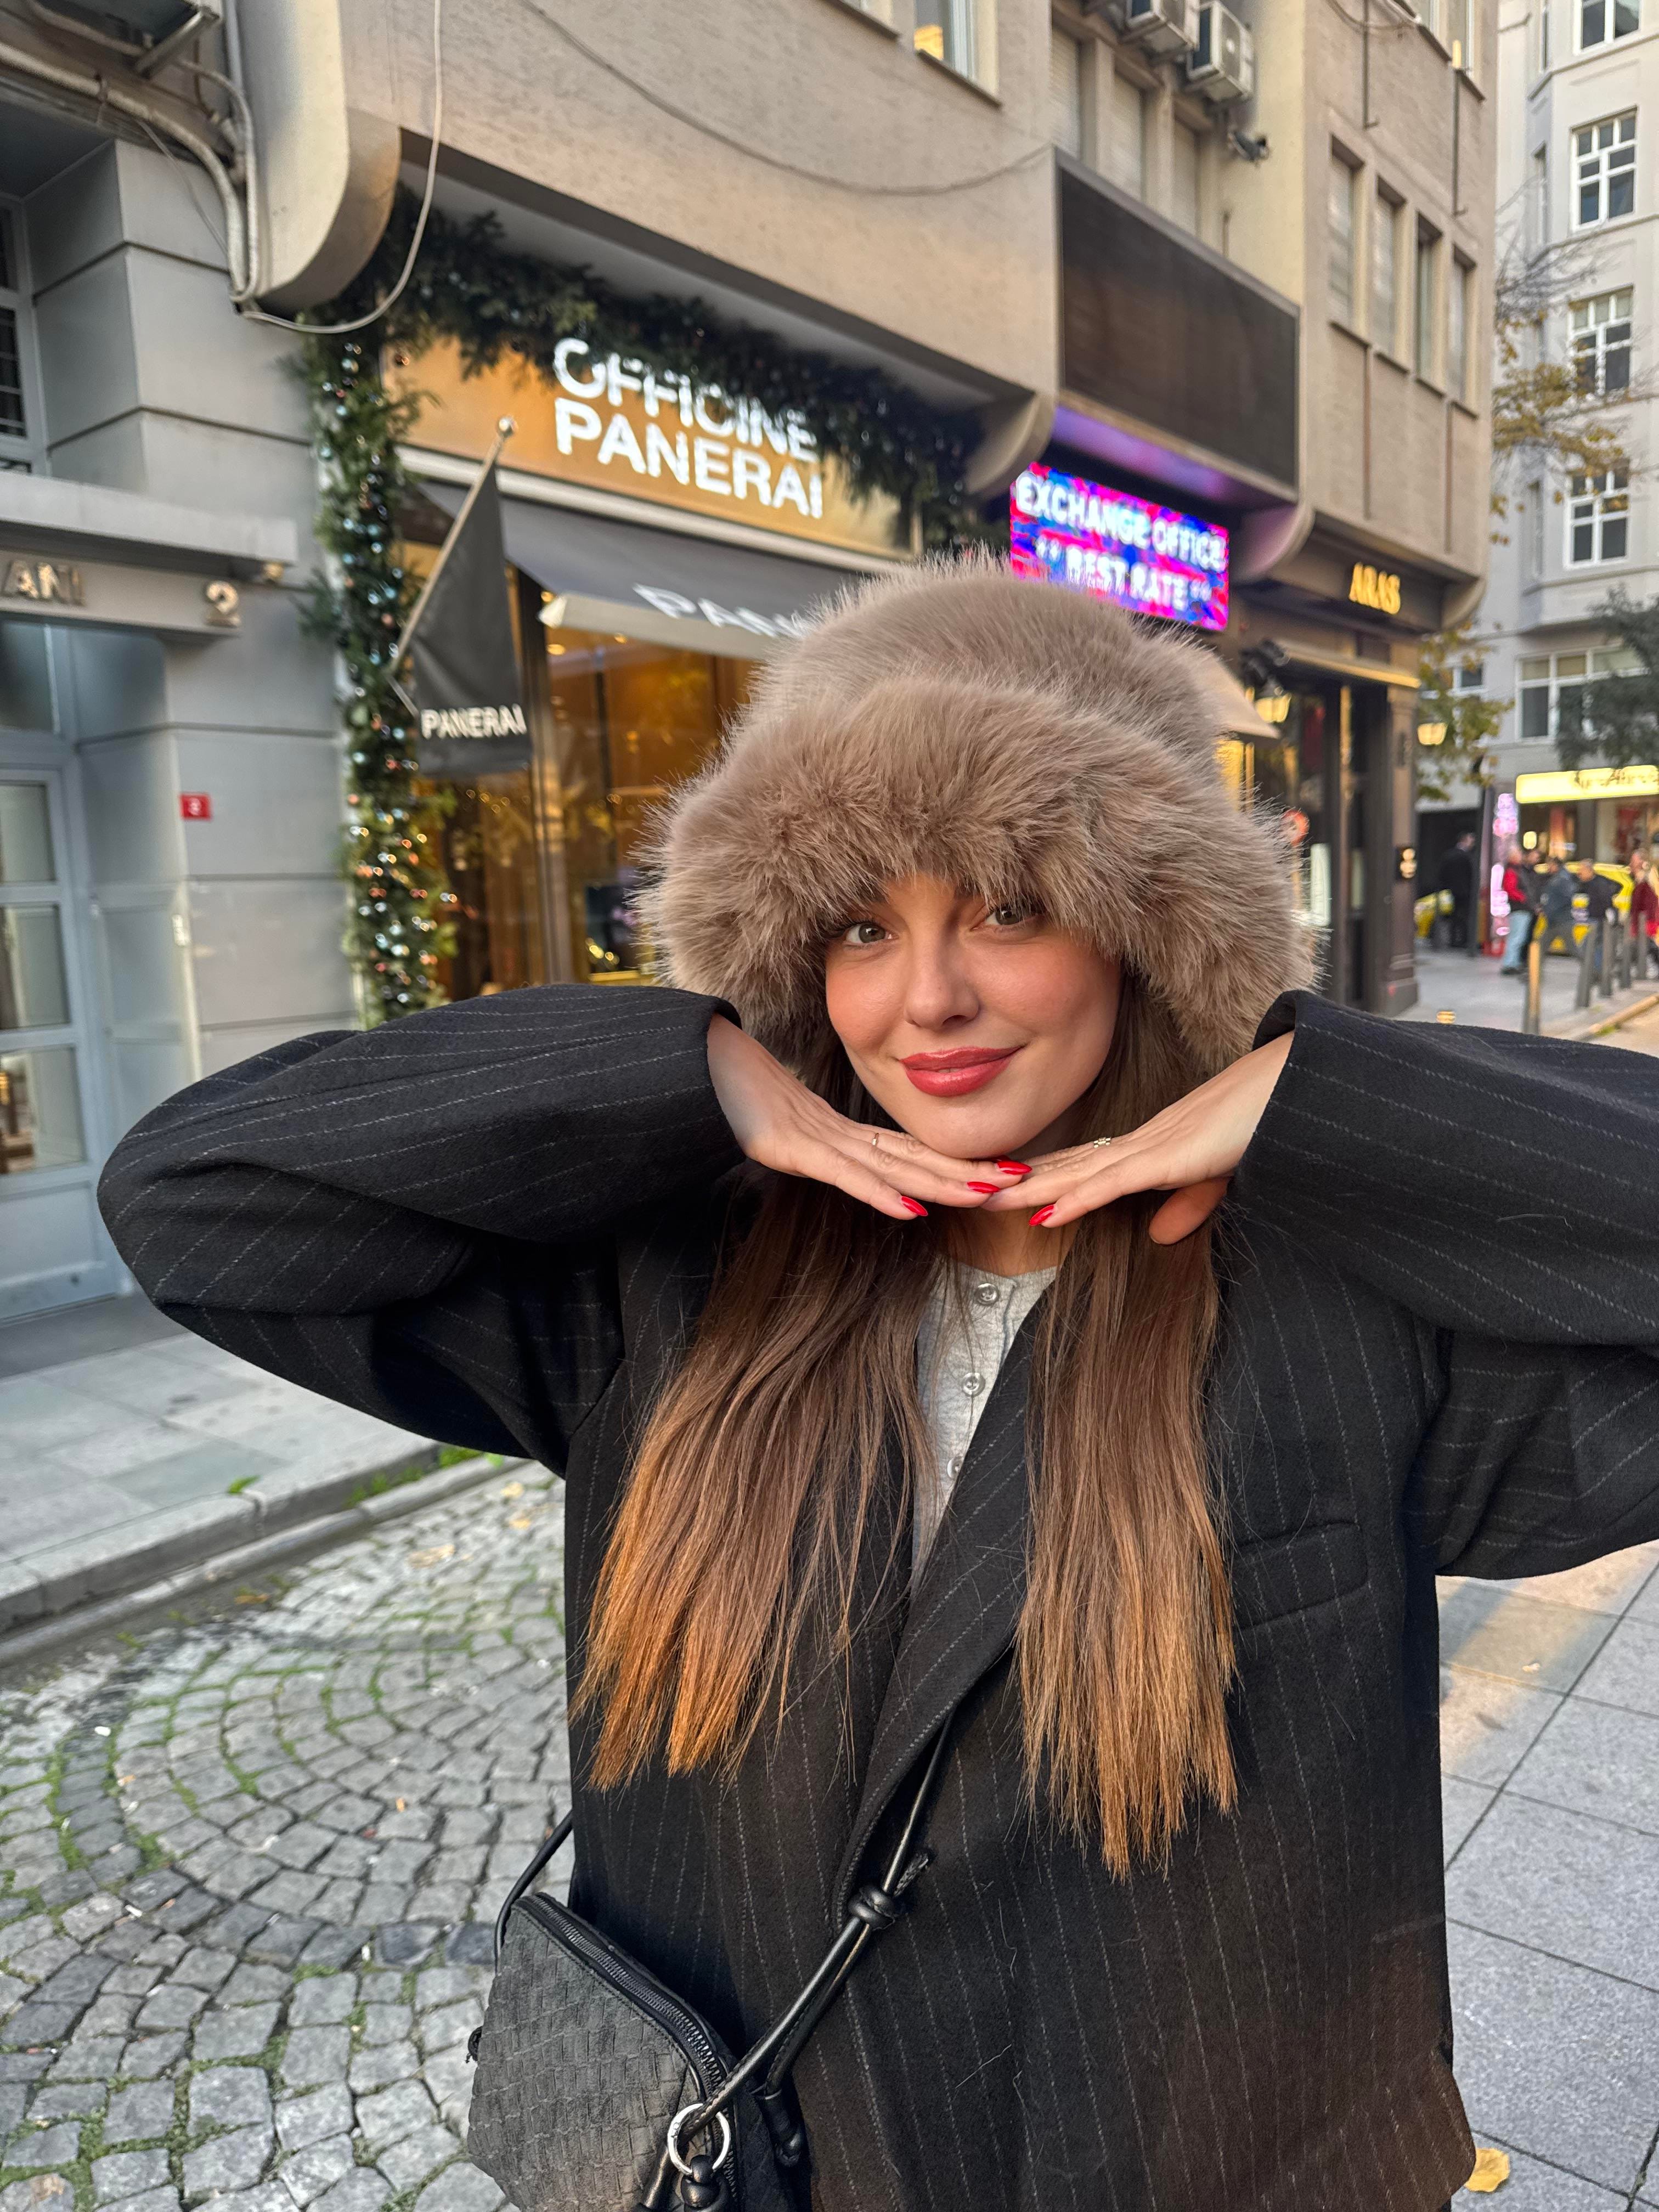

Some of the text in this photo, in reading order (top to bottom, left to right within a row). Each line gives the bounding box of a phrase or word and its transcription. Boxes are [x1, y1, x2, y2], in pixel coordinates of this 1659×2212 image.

[555, 398, 822, 518] PANERAI
[1017, 475, 1227, 572] EXCHANGE OFFICE
[205, 579, 241, 628] 2
[421, 703, 527, 740] PANERAI
